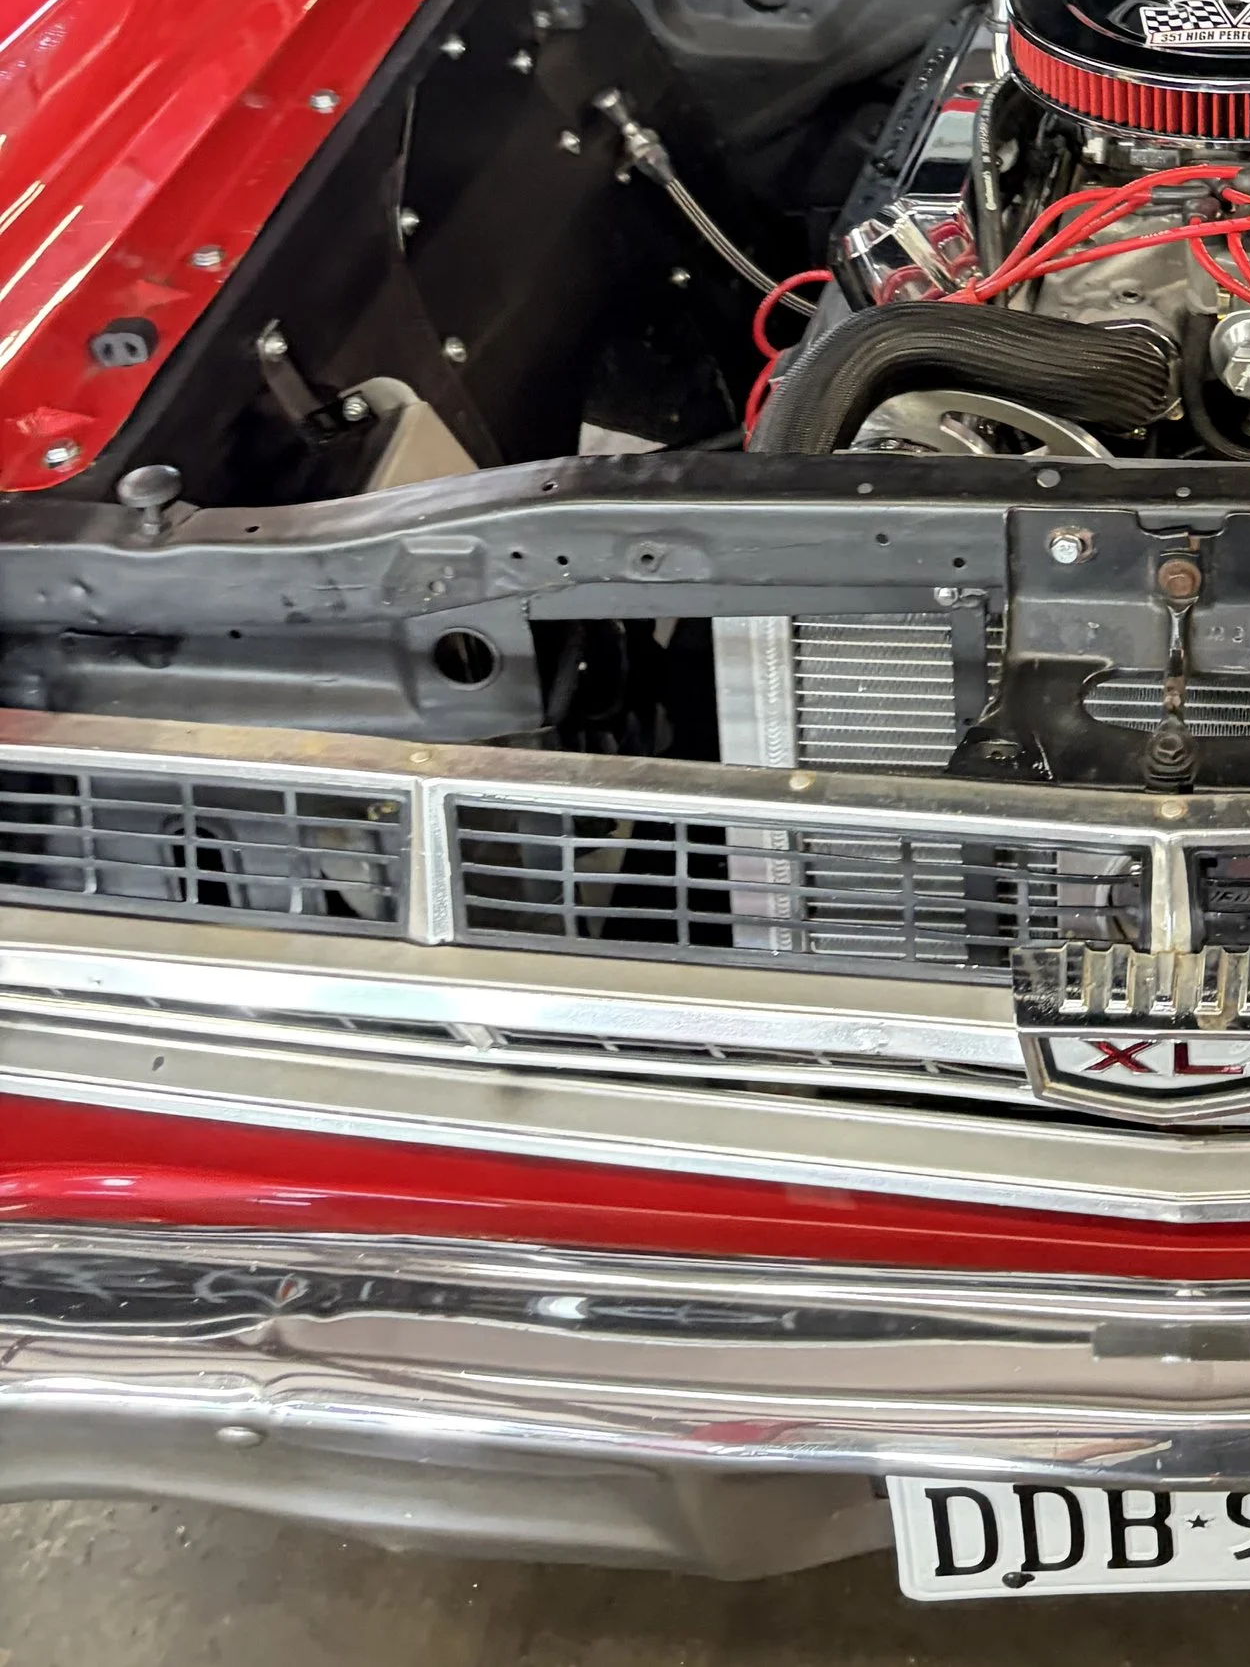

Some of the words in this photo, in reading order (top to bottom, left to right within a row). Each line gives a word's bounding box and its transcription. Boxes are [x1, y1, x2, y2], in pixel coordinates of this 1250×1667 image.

[1160, 33, 1182, 43] 351
[1185, 30, 1215, 41] HIGH
[1083, 1039, 1245, 1075] XL
